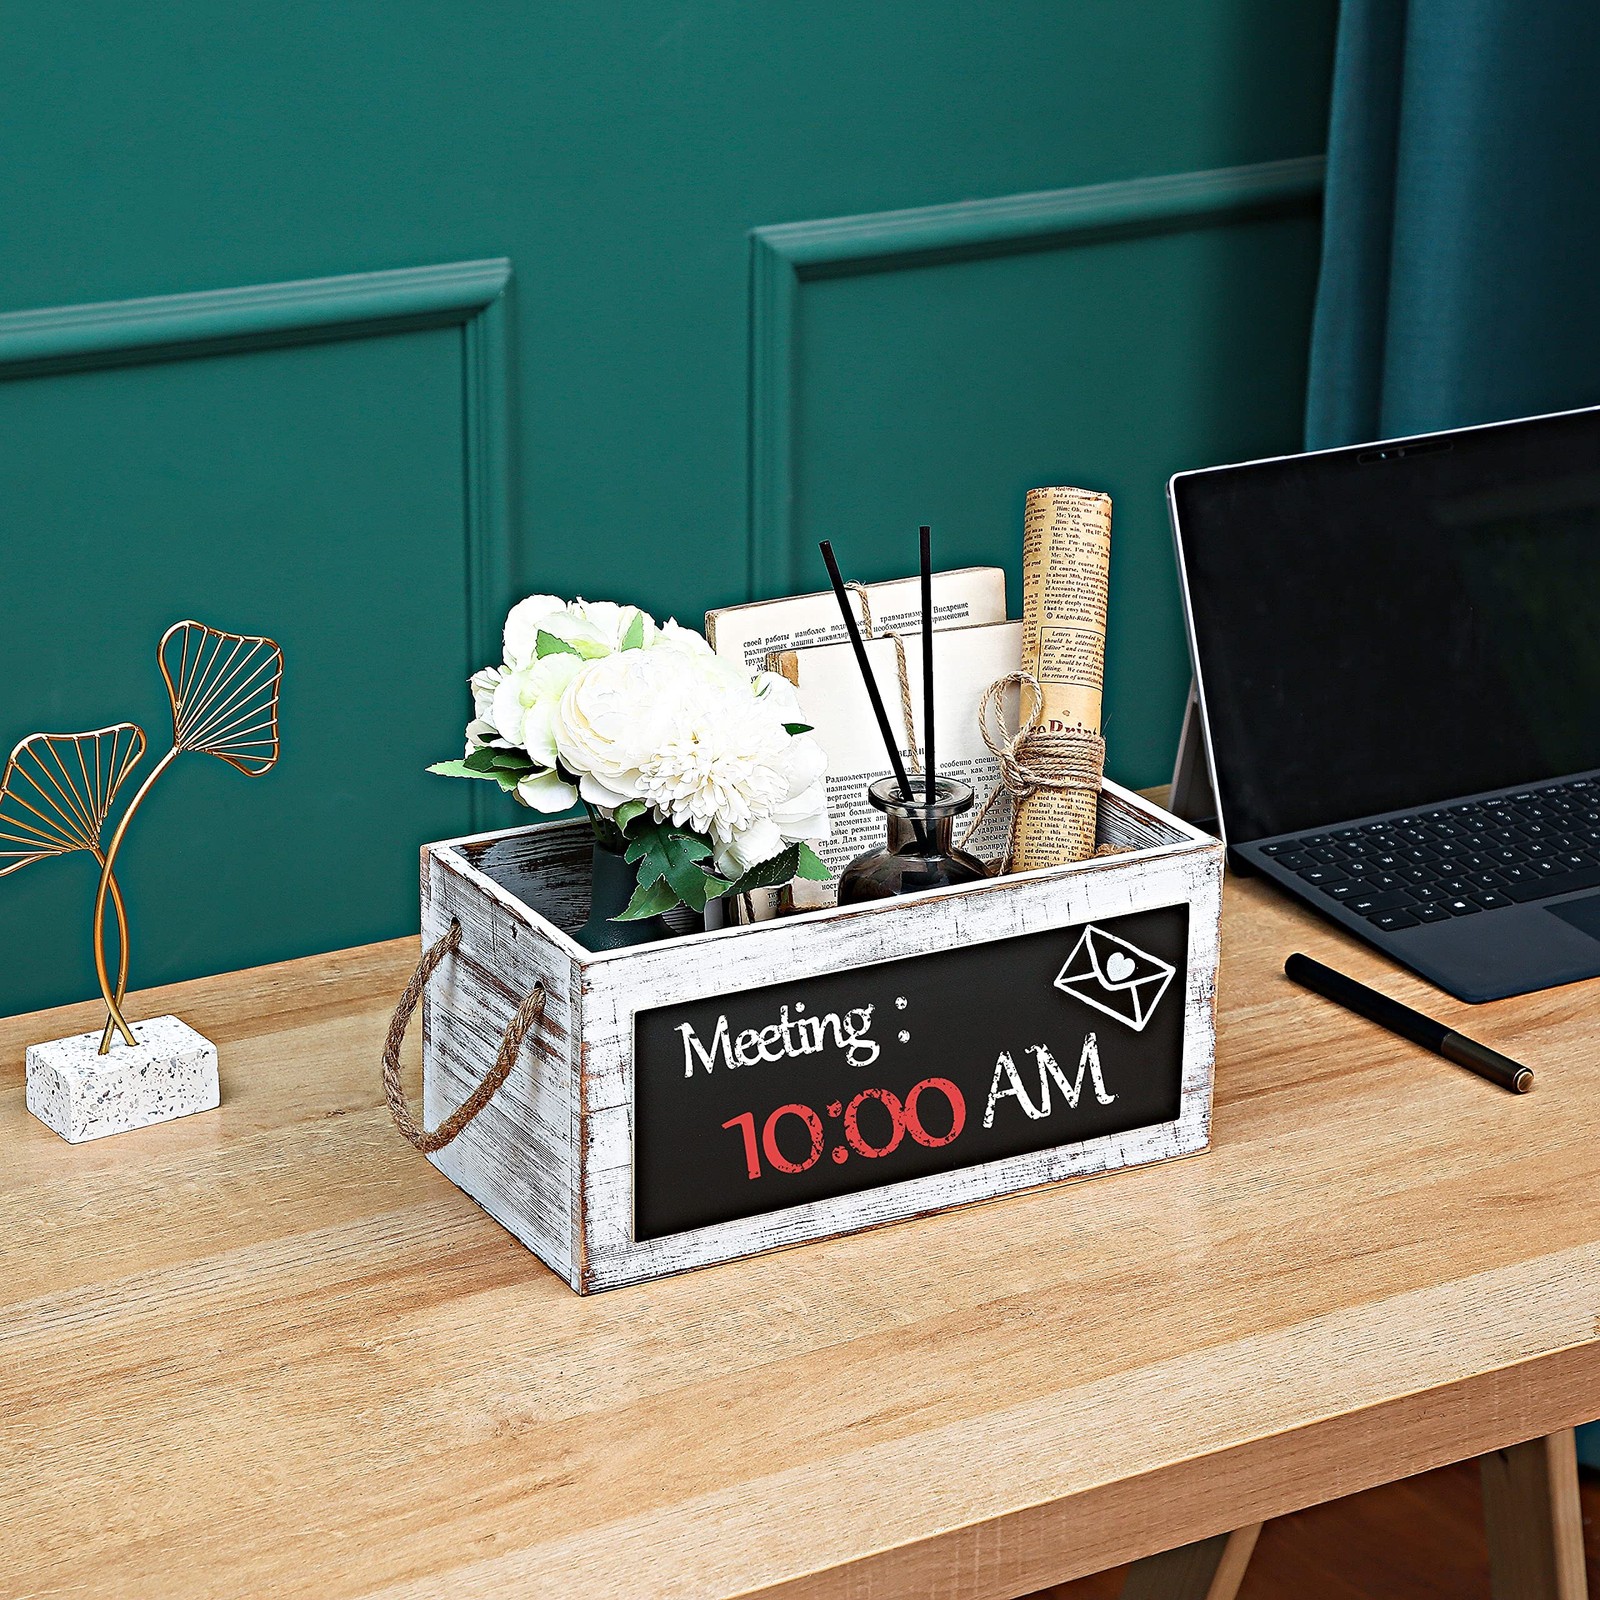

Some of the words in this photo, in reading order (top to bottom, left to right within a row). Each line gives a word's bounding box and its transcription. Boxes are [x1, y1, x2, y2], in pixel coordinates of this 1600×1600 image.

[933, 602, 968, 613] Внедрение
[743, 638, 762, 648] своей
[765, 634, 790, 645] работы
[795, 627, 826, 638] наиболее
[791, 638, 814, 647] машин
[940, 760, 971, 768] особенно
[826, 770, 891, 783] Радиоэлектронная
[674, 1002, 881, 1079] Meeting
[721, 1076, 968, 1181] 10:00
[982, 1031, 1120, 1130] AM
